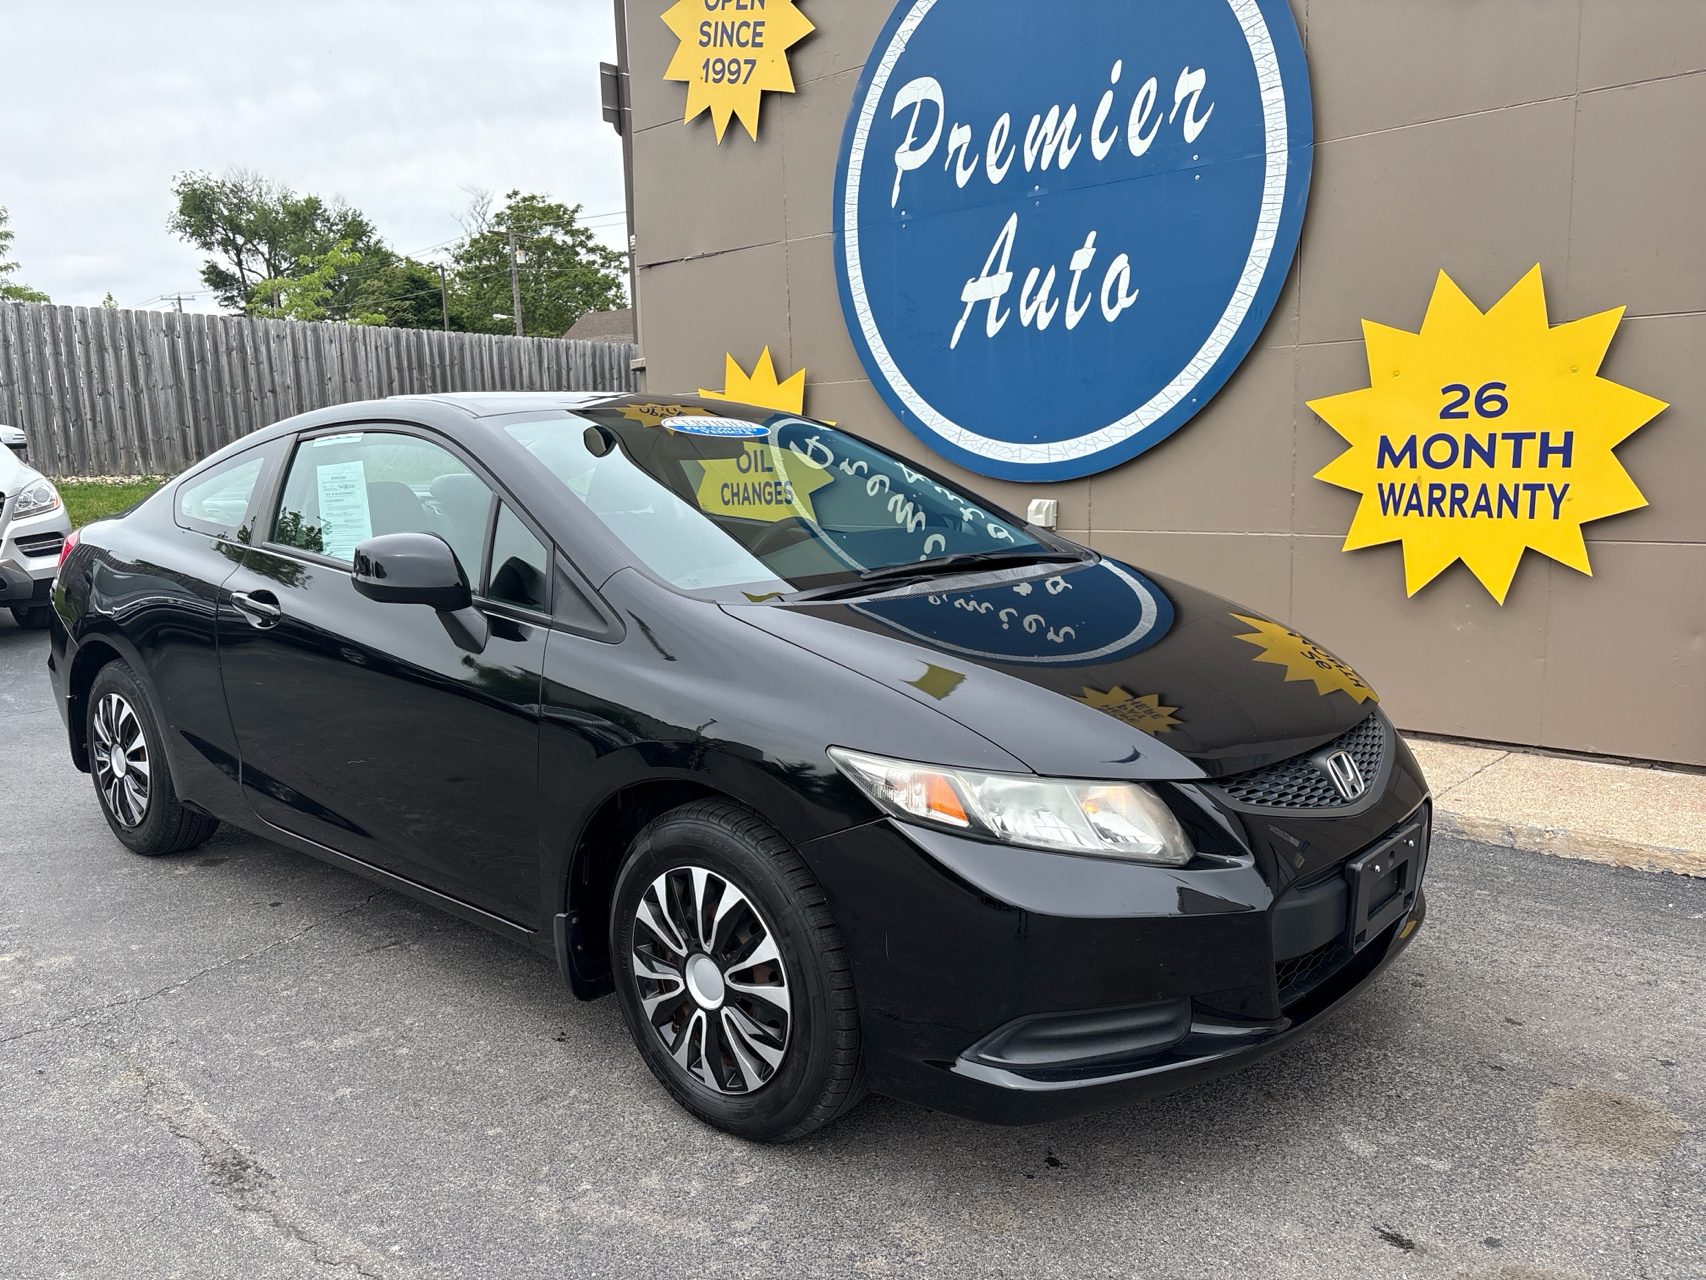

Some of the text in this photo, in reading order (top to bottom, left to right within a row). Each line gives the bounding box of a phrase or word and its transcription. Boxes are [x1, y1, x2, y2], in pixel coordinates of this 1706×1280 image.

[698, 20, 766, 48] SINCE
[702, 57, 757, 85] 1997
[890, 59, 1215, 209] Premier
[949, 212, 1140, 350] Auto
[1439, 381, 1509, 420] 26
[736, 449, 774, 474] OIL
[1376, 431, 1575, 469] MONTH
[720, 481, 794, 506] CHANGES
[1377, 482, 1571, 520] WARRANTY
